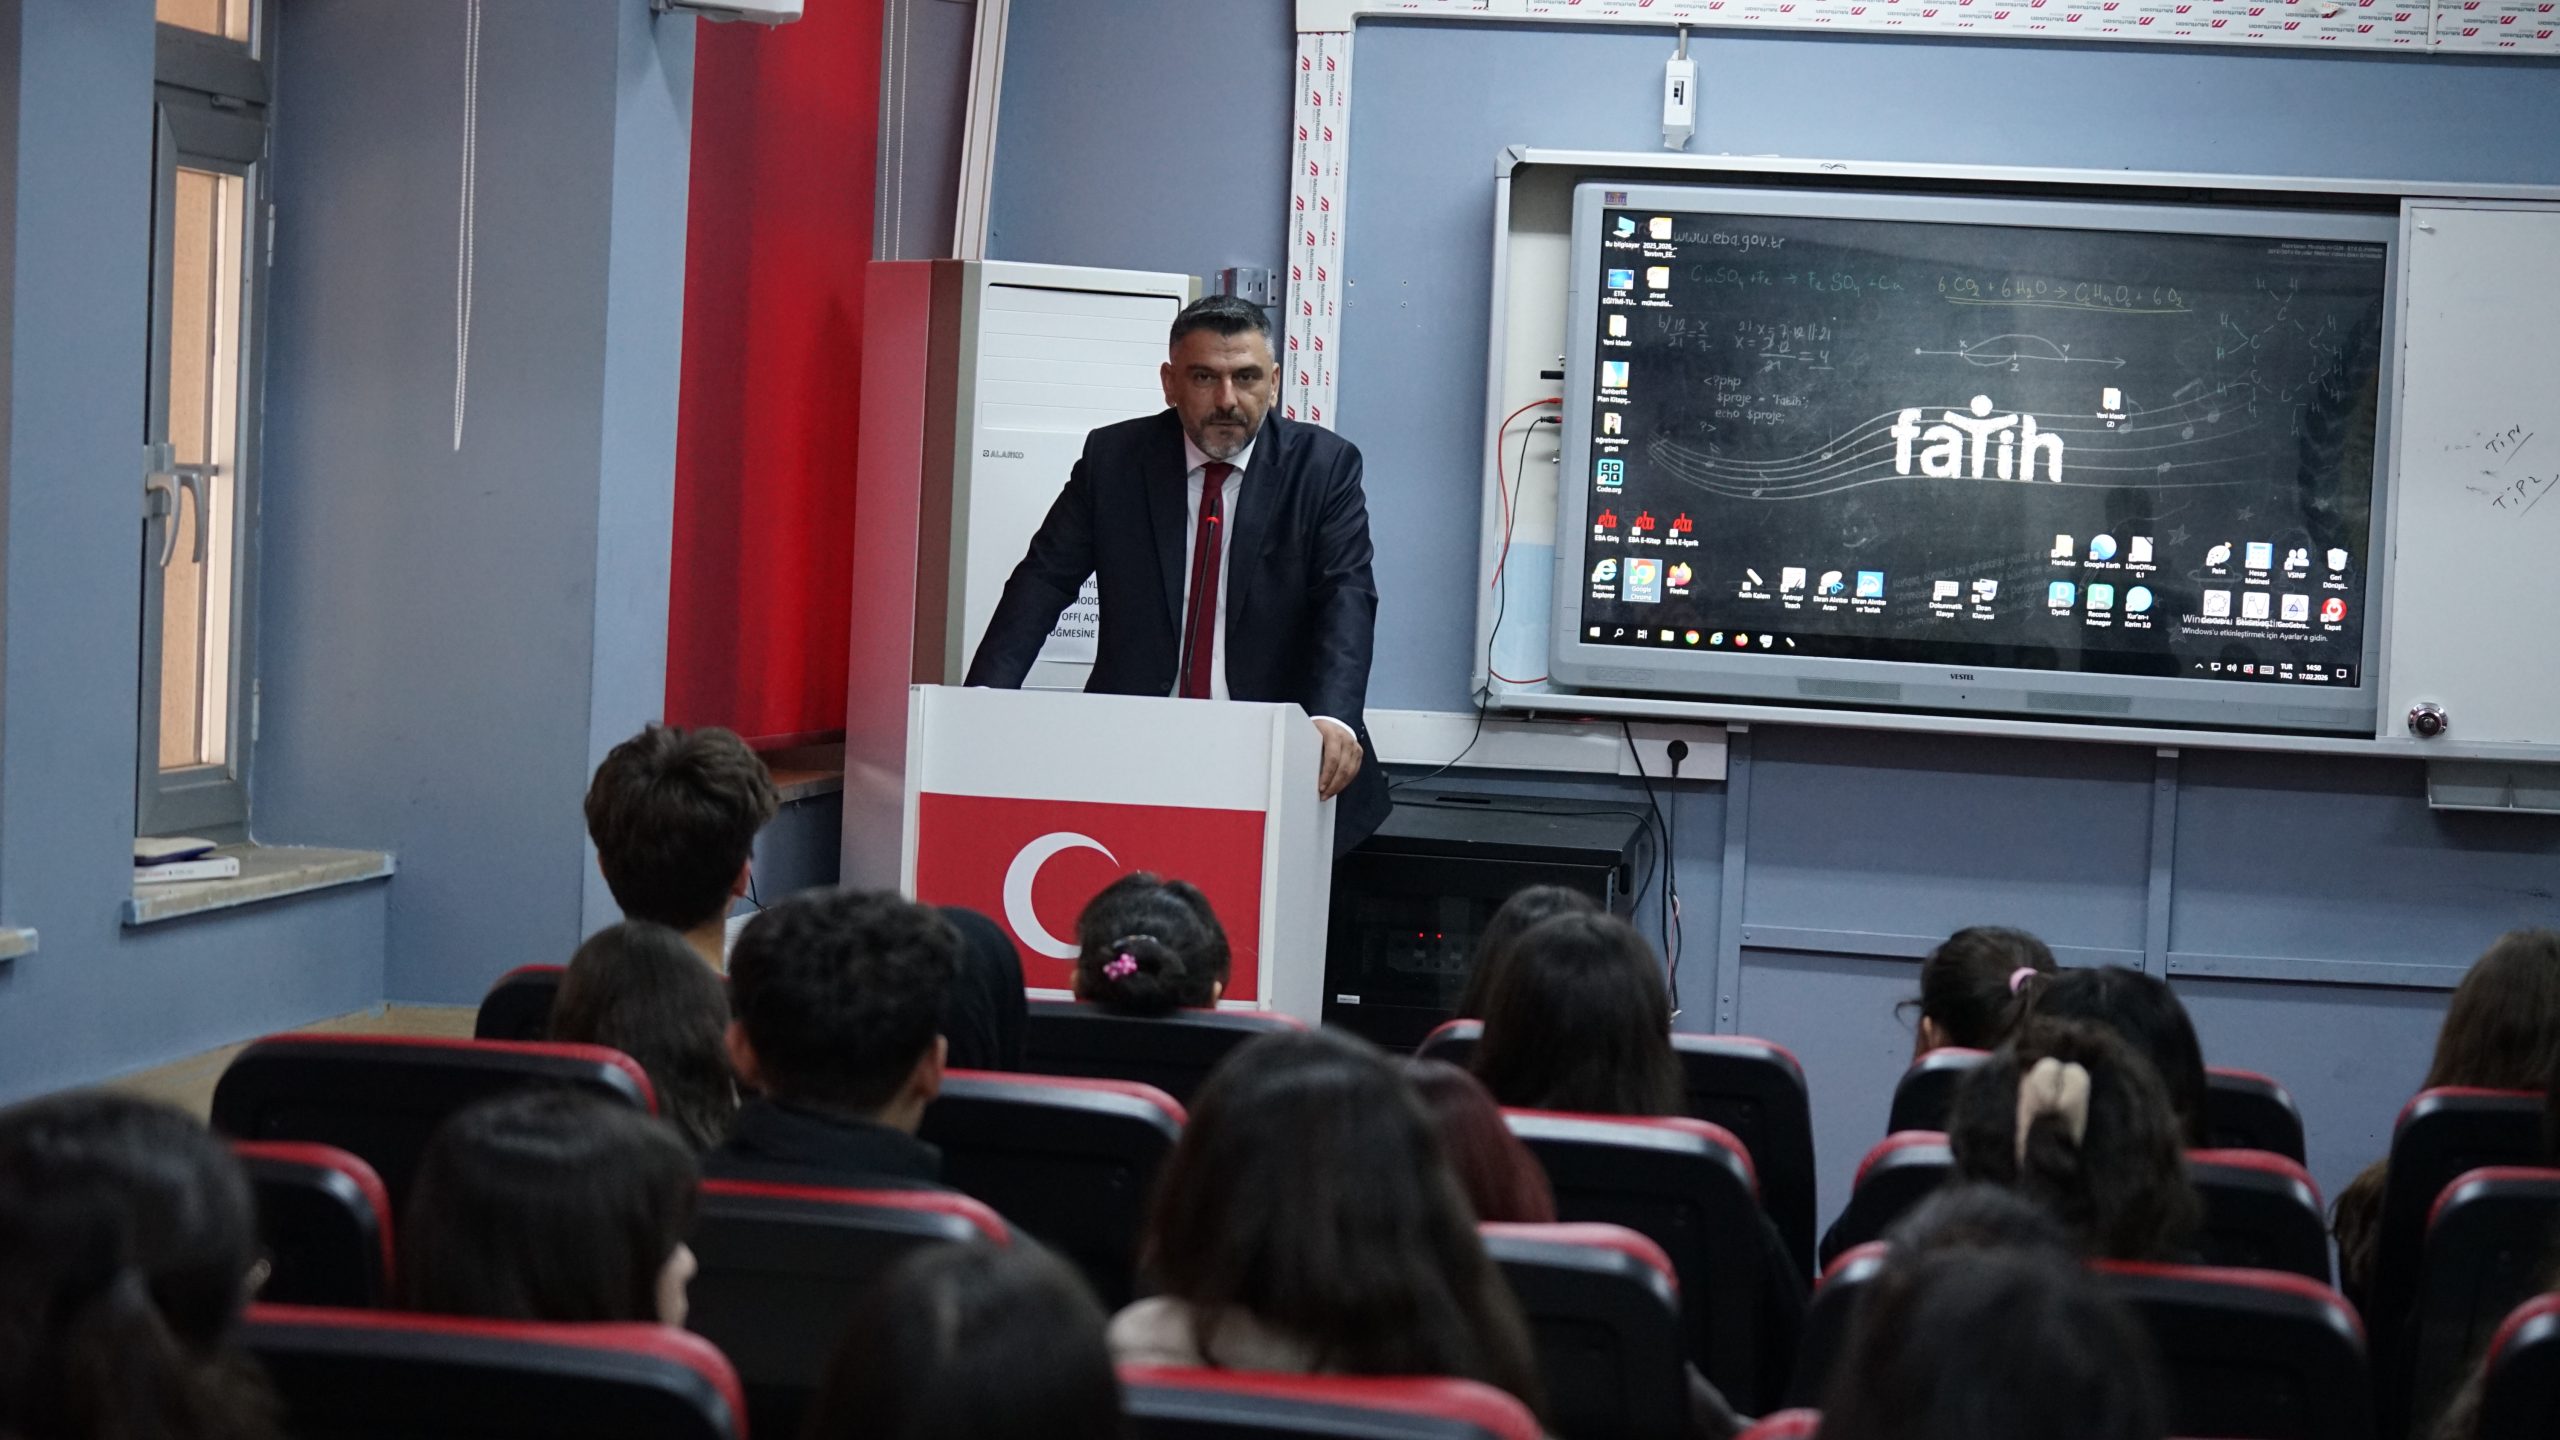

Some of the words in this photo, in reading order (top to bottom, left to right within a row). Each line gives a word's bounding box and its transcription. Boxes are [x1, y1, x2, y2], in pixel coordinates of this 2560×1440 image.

[1673, 231, 1785, 253] www.eba.gov.tr
[1715, 409, 1740, 418] echo
[1596, 486, 1622, 495] Code.org
[2084, 561, 2105, 569] Google
[2212, 567, 2226, 575] Paint
[2249, 570, 2267, 578] Hesap
[1631, 586, 1651, 594] Google
[1669, 587, 1689, 595] Firefox
[1592, 591, 1615, 599] Explorer
[1936, 610, 1954, 618] Klavye
[2088, 611, 2110, 619] Records
[2086, 618, 2112, 627] Manager
[2181, 627, 2219, 636] Windows'u
[2220, 630, 2266, 640] etkinleştirmek
[2266, 632, 2278, 640] için
[2279, 633, 2308, 642] Ayarlar'a
[2309, 635, 2328, 643] gidin.
[1950, 673, 1975, 681] VESTEL
